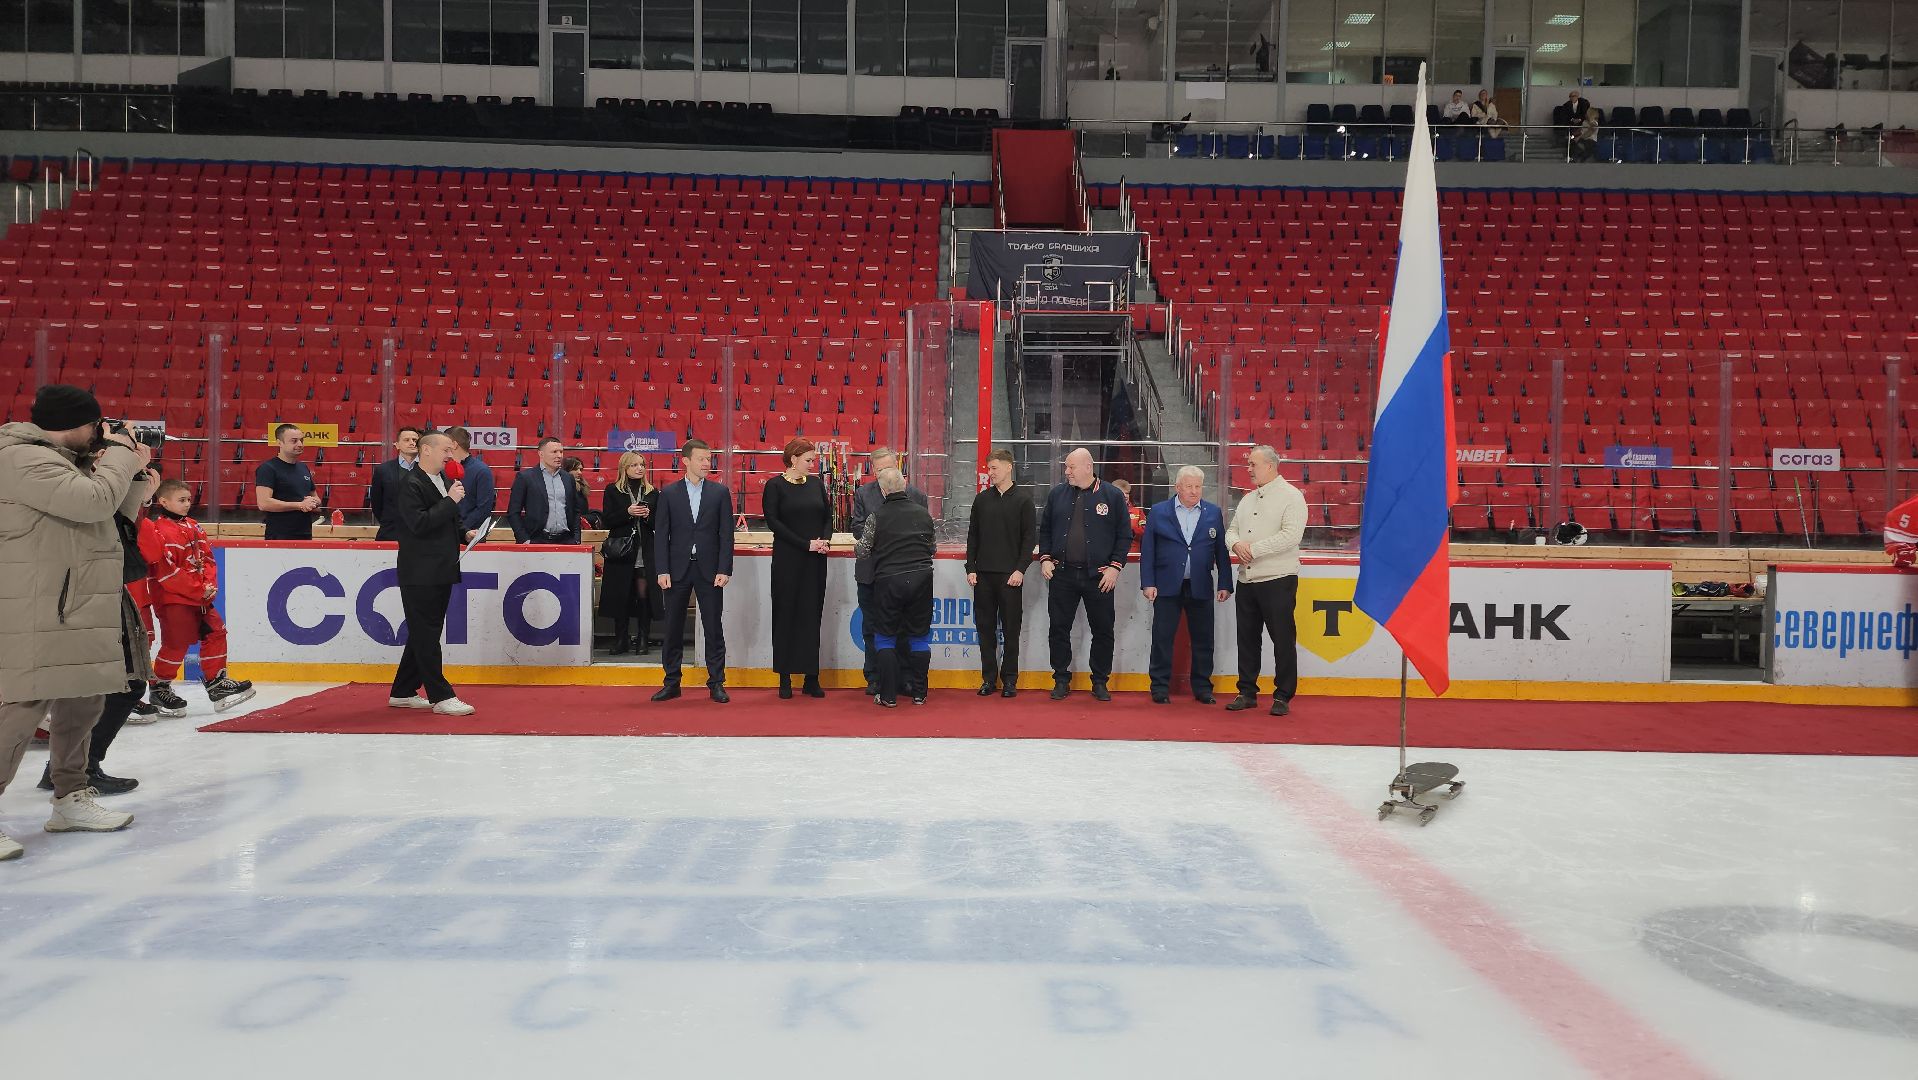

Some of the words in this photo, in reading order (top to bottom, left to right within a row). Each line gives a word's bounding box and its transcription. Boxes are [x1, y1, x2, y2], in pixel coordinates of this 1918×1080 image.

[1008, 242, 1045, 251] ТОЛЬКО
[301, 431, 330, 440] АНК
[1900, 513, 1911, 528] 5
[1448, 602, 1571, 641] АНК
